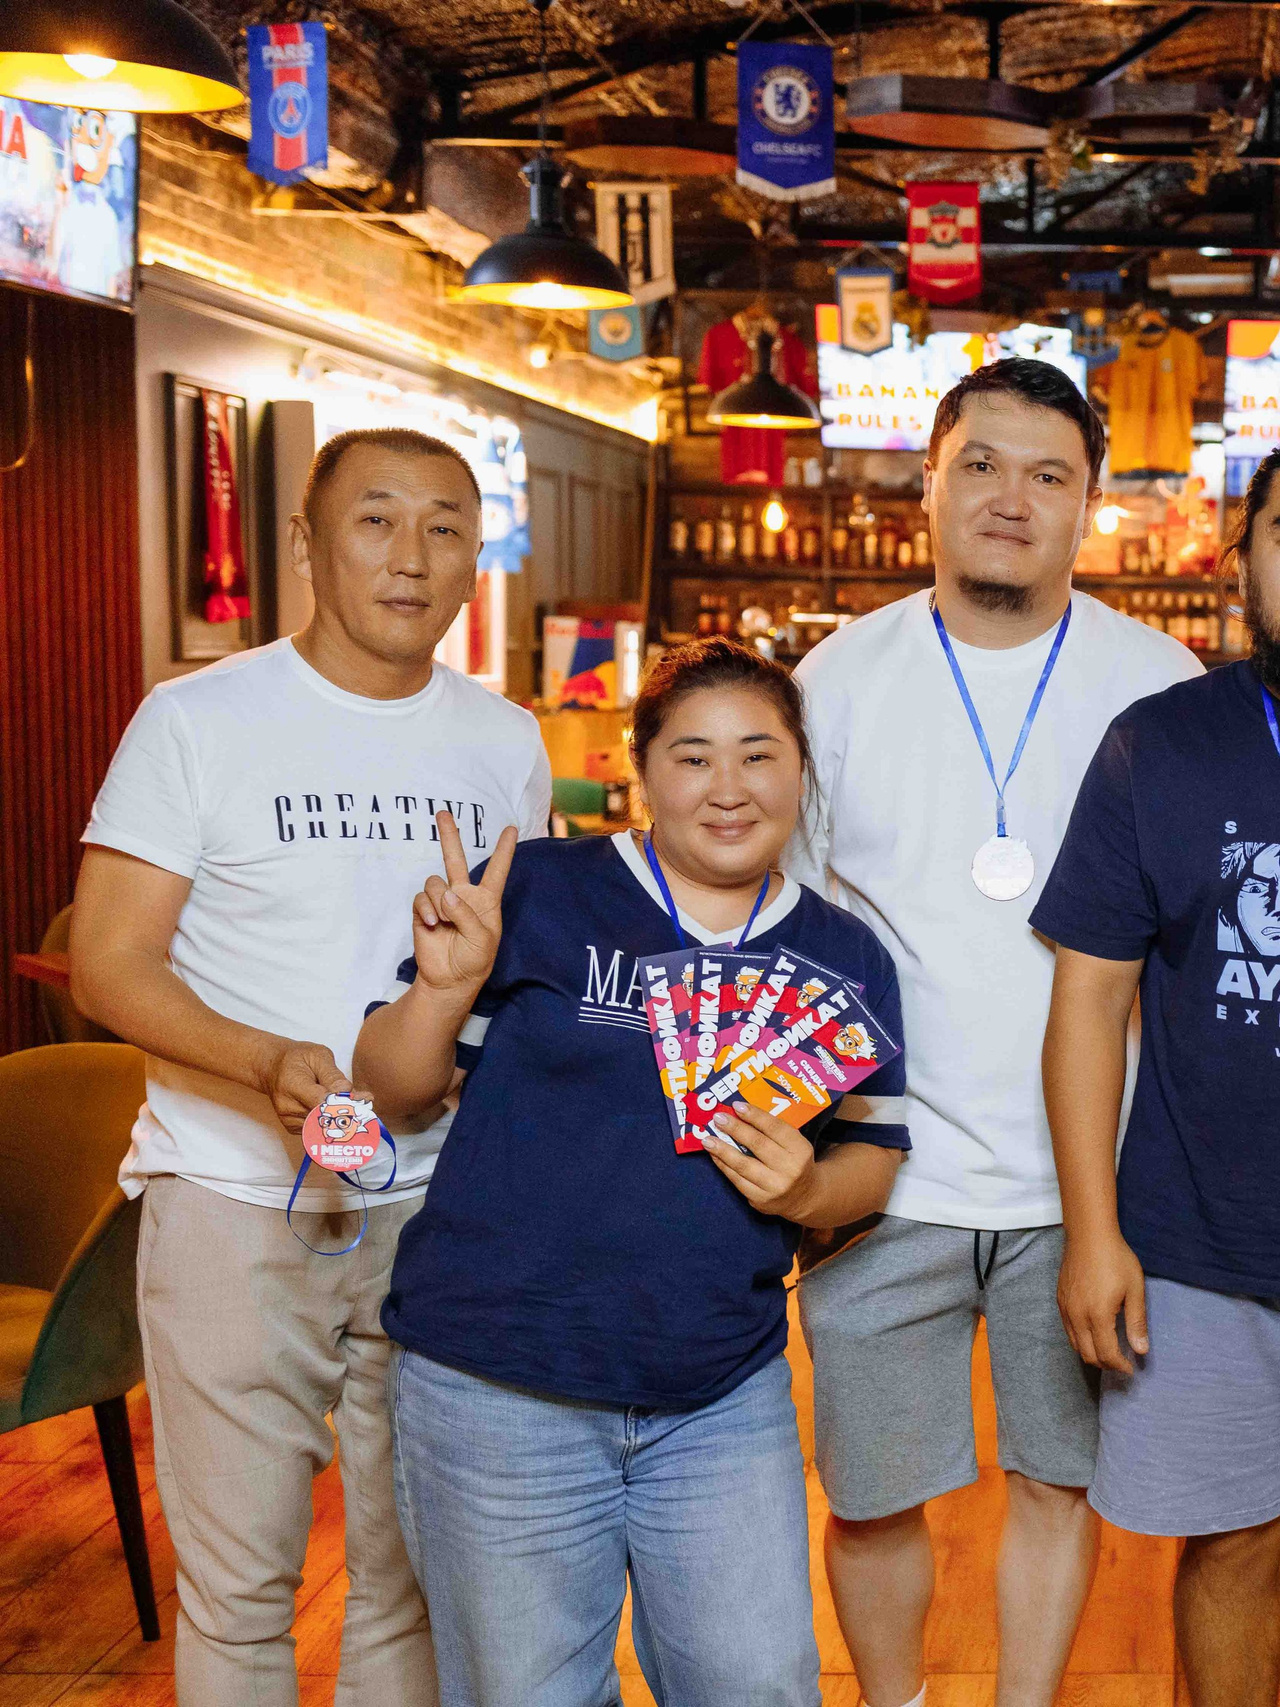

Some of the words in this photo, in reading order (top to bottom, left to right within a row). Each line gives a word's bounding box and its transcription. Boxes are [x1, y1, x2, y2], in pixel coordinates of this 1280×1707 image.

[0, 109, 28, 160] A
[837, 383, 939, 400] BANAN
[838, 414, 923, 431] RULES
[1225, 820, 1237, 834] S
[697, 990, 850, 1111] СЕРТИФИКАТ
[787, 1059, 799, 1073] НА
[800, 1059, 828, 1092] СКИДКА
[777, 1074, 793, 1093] 50%
[790, 1090, 802, 1104] НА
[310, 1144, 318, 1156] 1
[320, 1144, 374, 1157] МЕСТО
